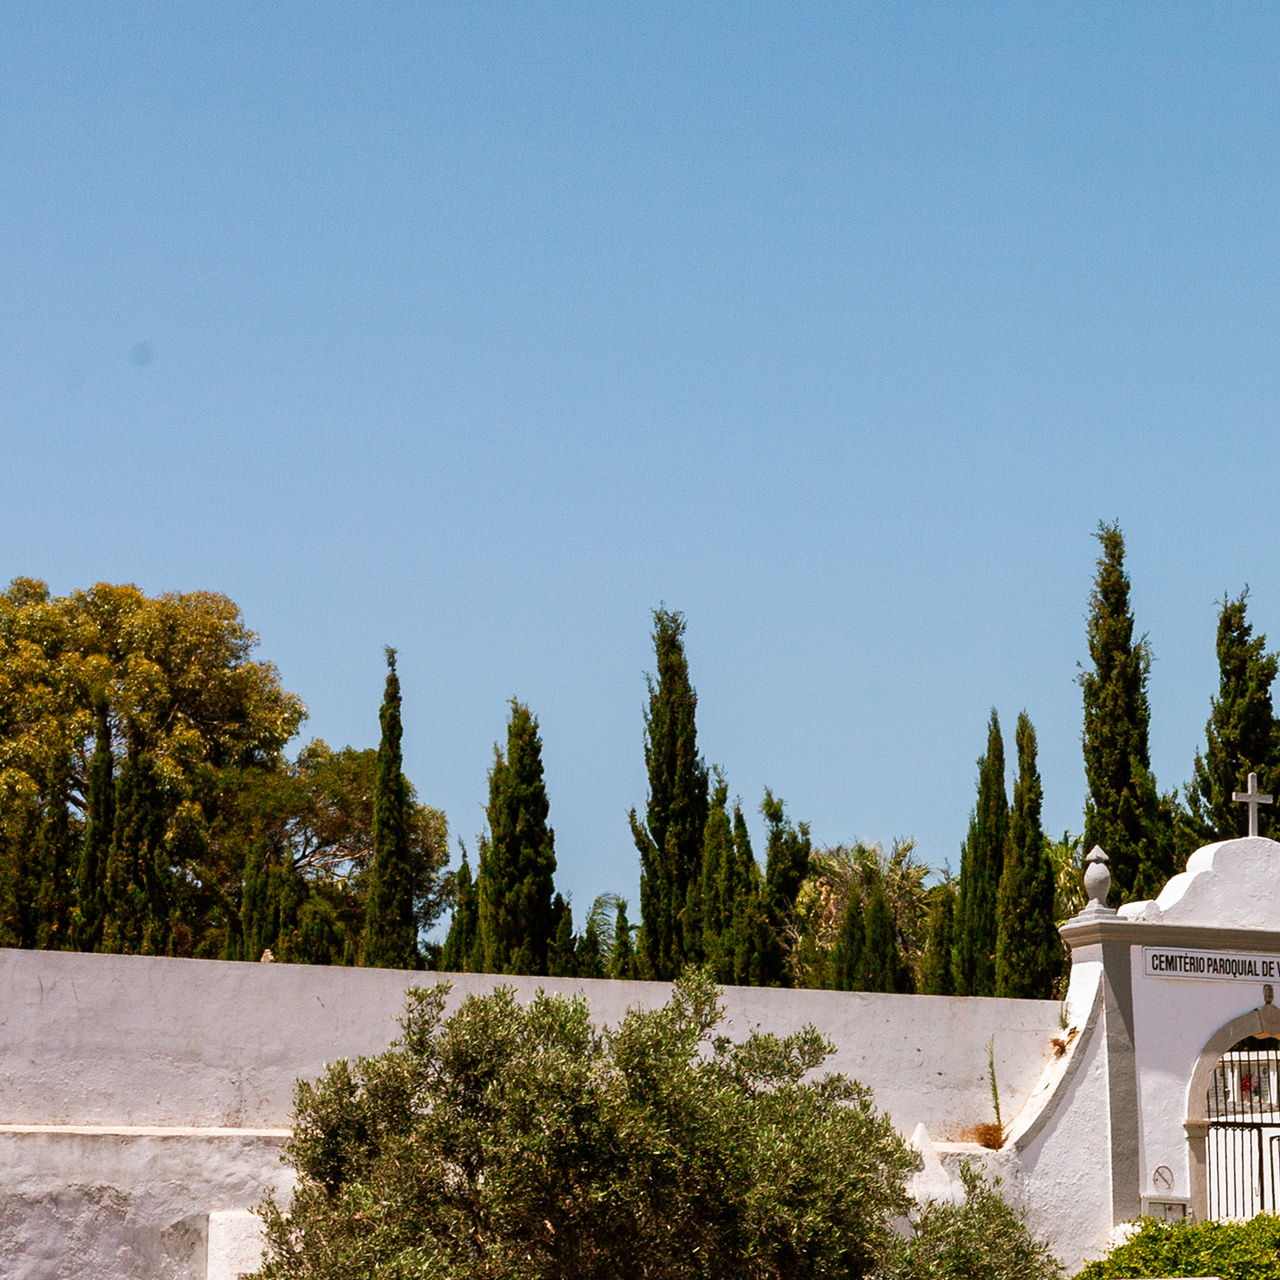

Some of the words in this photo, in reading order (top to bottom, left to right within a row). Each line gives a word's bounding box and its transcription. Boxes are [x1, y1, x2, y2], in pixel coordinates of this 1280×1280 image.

[1151, 953, 1205, 973] CEMITÉRIO
[1206, 957, 1260, 978] PAROQUIAL
[1261, 961, 1275, 977] DE
